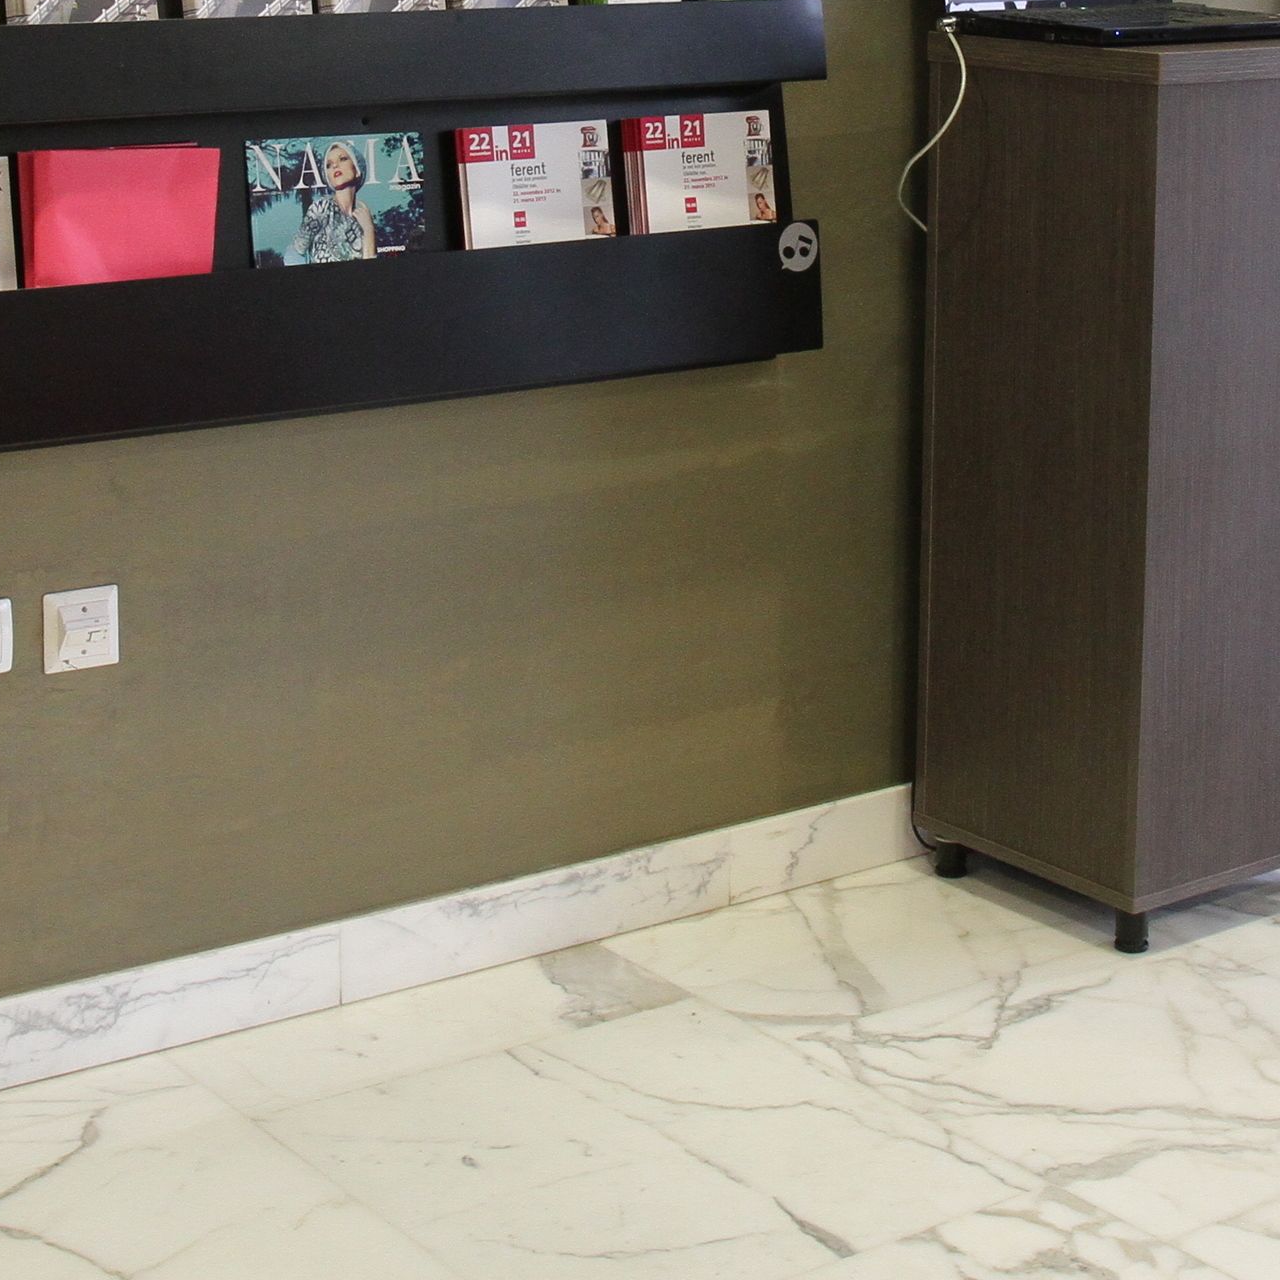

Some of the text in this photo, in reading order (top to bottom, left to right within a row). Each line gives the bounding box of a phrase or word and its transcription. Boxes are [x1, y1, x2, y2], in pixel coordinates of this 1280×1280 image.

[469, 131, 531, 161] 22 in 21
[645, 120, 701, 150] 22 in 21
[682, 150, 715, 164] ferent
[511, 162, 546, 177] ferent
